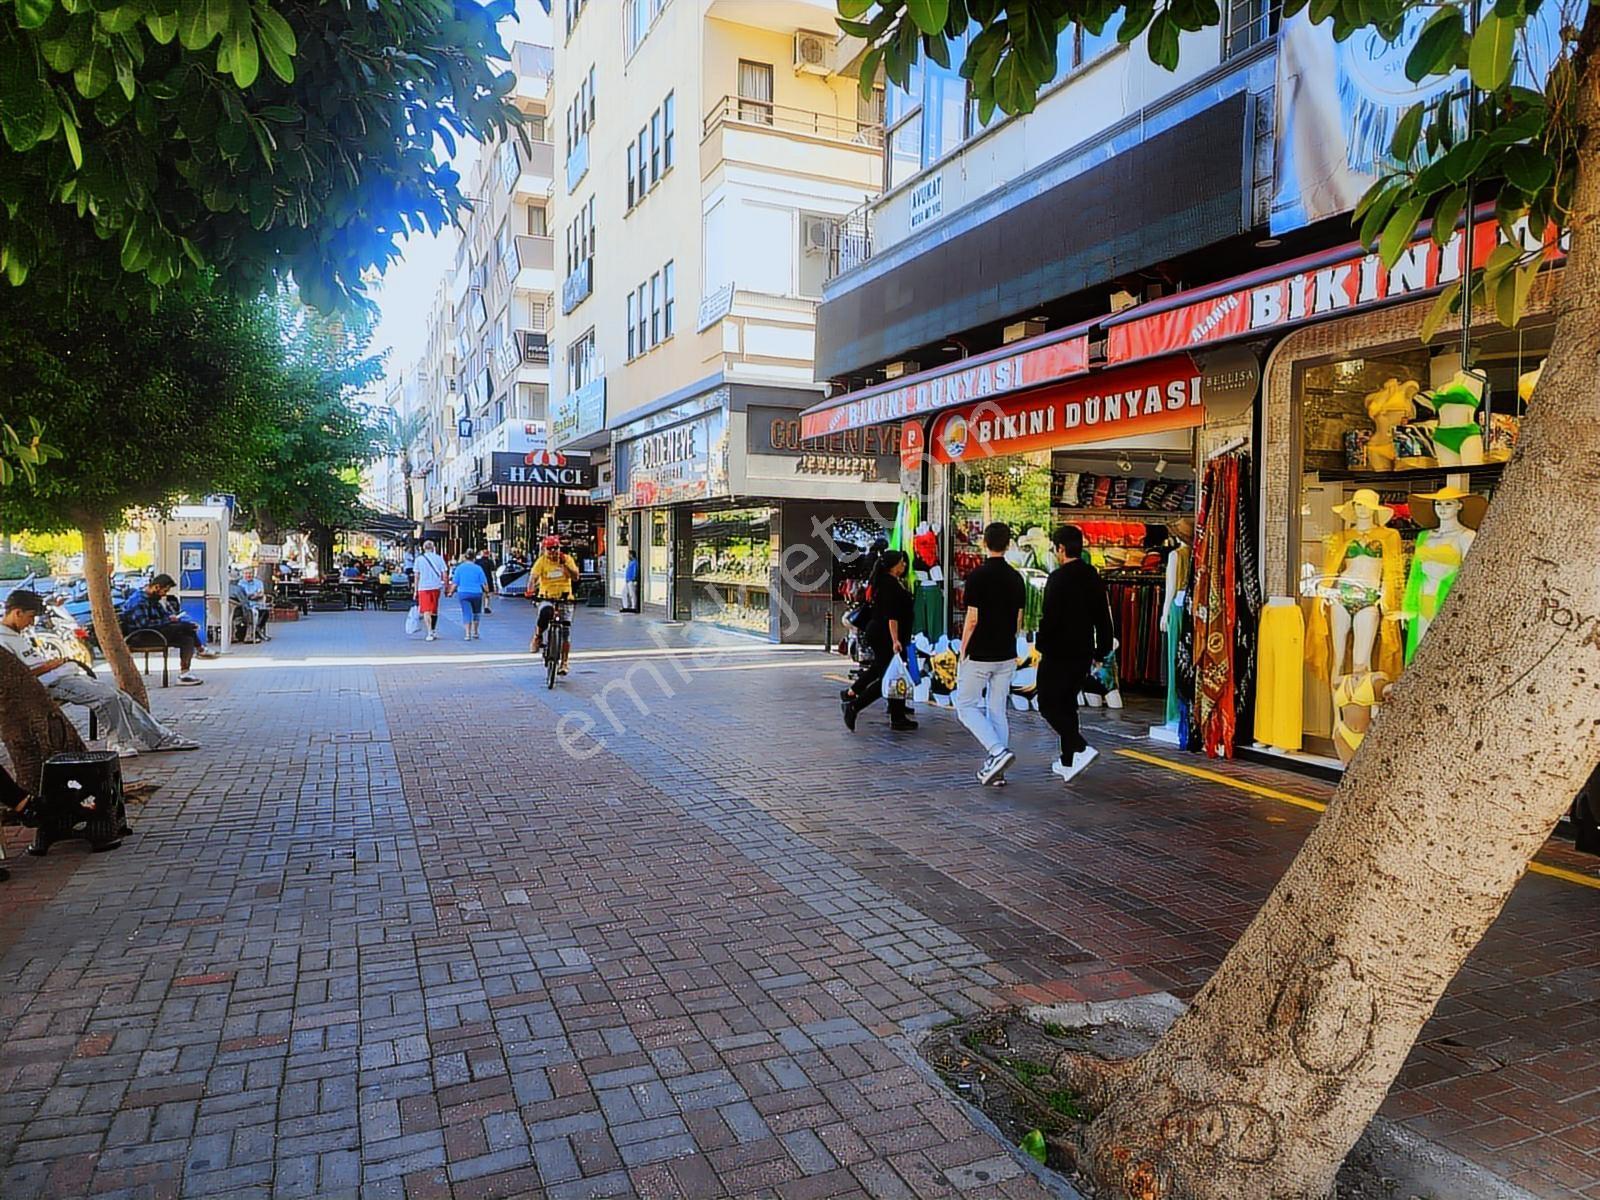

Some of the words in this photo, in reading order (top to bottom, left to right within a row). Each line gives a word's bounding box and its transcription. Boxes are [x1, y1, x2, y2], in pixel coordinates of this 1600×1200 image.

[1190, 295, 1239, 343] ALANYA
[1065, 376, 1203, 429] DÜNYASI
[509, 466, 583, 485] HANCI
